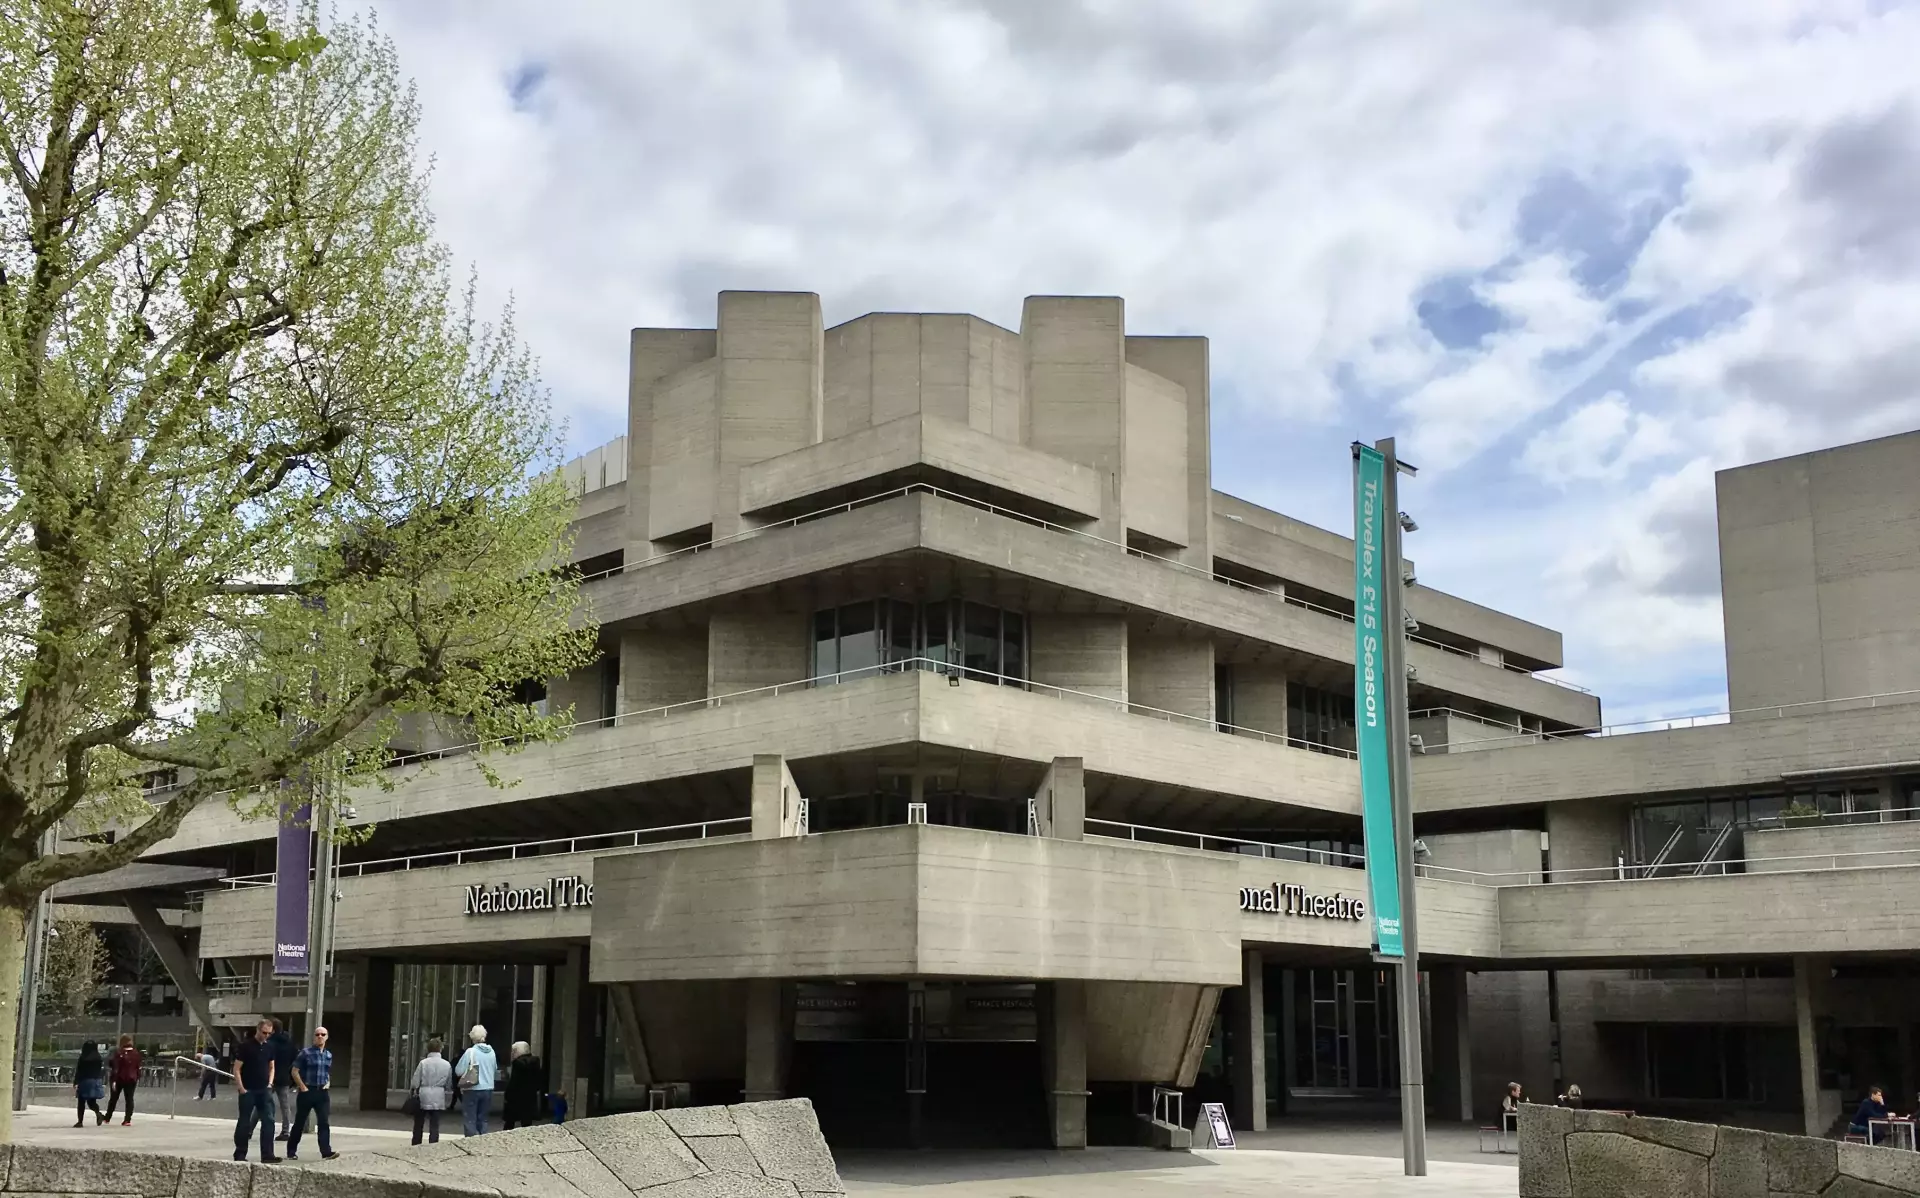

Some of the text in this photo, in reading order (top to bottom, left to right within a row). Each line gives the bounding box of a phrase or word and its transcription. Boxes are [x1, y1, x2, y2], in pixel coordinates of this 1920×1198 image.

[1363, 480, 1377, 728] Travelex £15 Season
[464, 878, 553, 914] National
[1285, 884, 1365, 920] Theatre
[1379, 916, 1400, 927] National
[278, 943, 306, 951] National
[278, 950, 304, 958] Theatre
